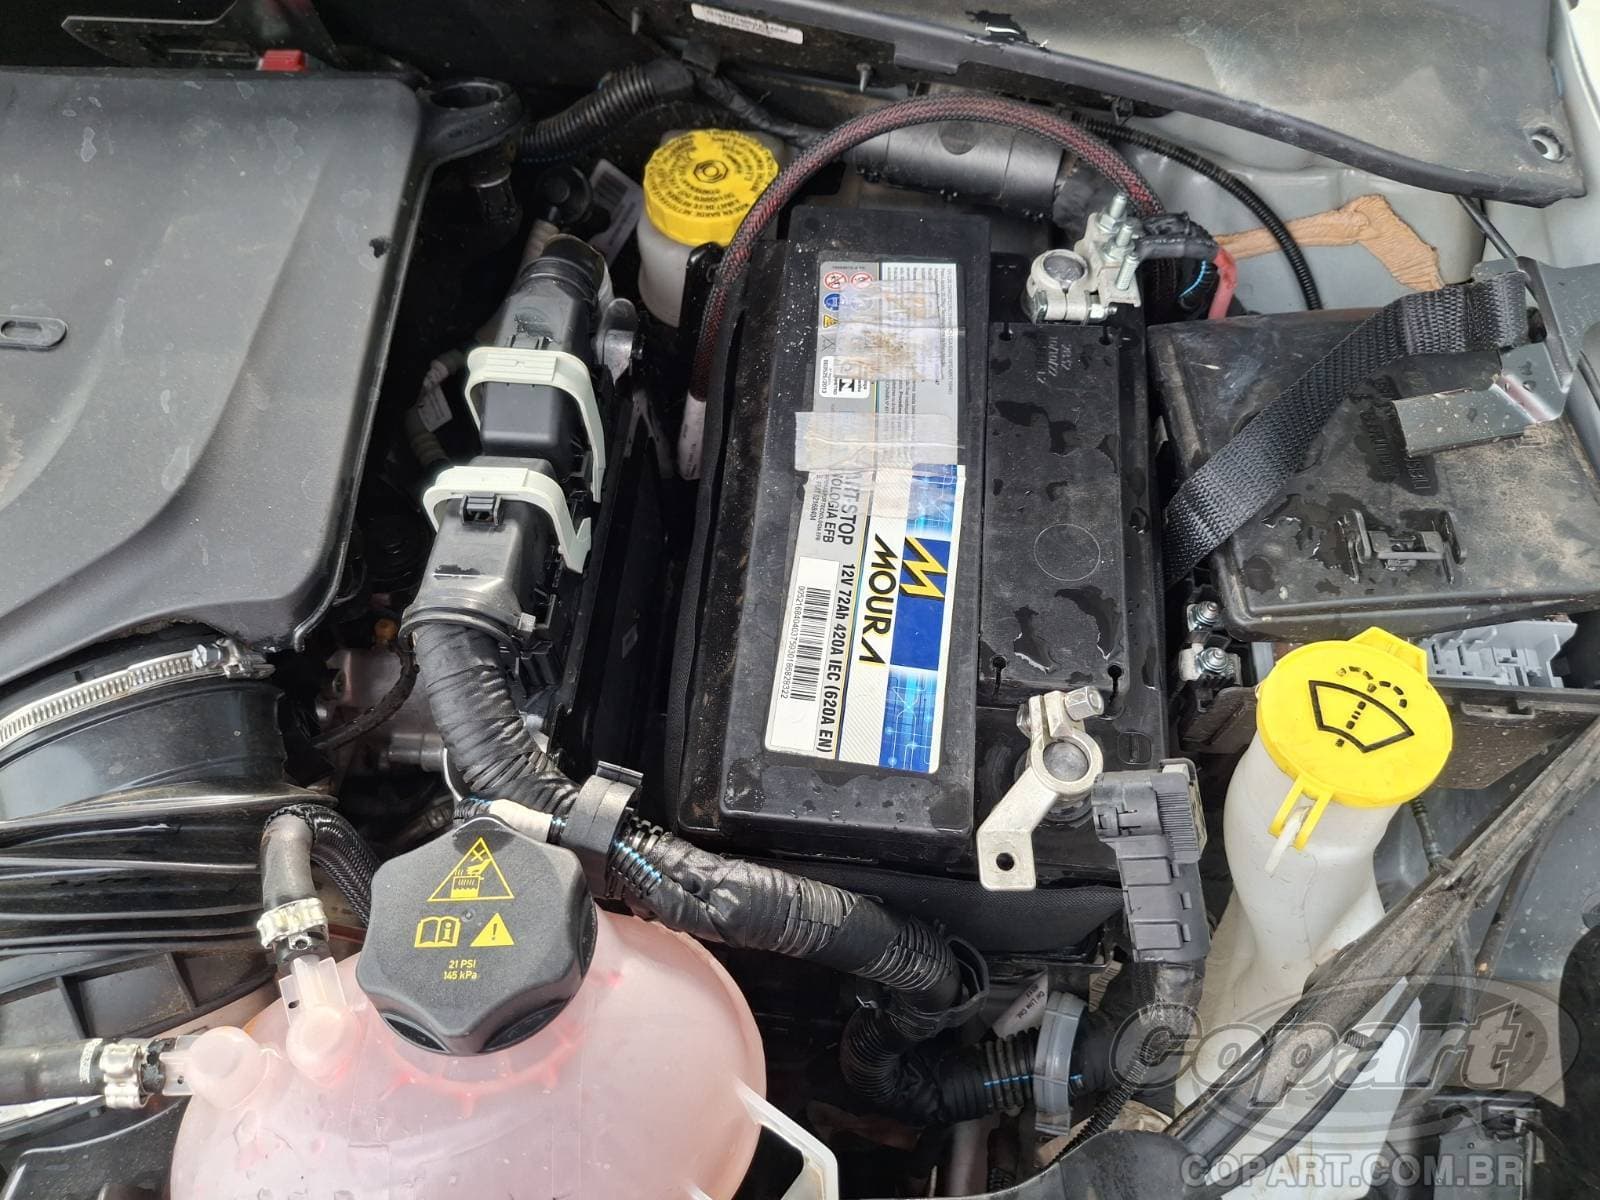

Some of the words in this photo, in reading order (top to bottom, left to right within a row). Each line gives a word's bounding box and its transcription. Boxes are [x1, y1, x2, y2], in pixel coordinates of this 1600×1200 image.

[822, 522, 837, 543] EFB
[840, 563, 856, 587] 12V
[835, 589, 852, 620] 72Ah
[858, 534, 900, 663] MOURA
[830, 623, 847, 655] 420A
[826, 660, 842, 681] IEC
[821, 685, 840, 726] (620A
[816, 730, 834, 753] EN)
[443, 971, 457, 980] 145
[459, 970, 478, 980] kPa
[448, 960, 458, 969] 21
[460, 959, 476, 969] PSI
